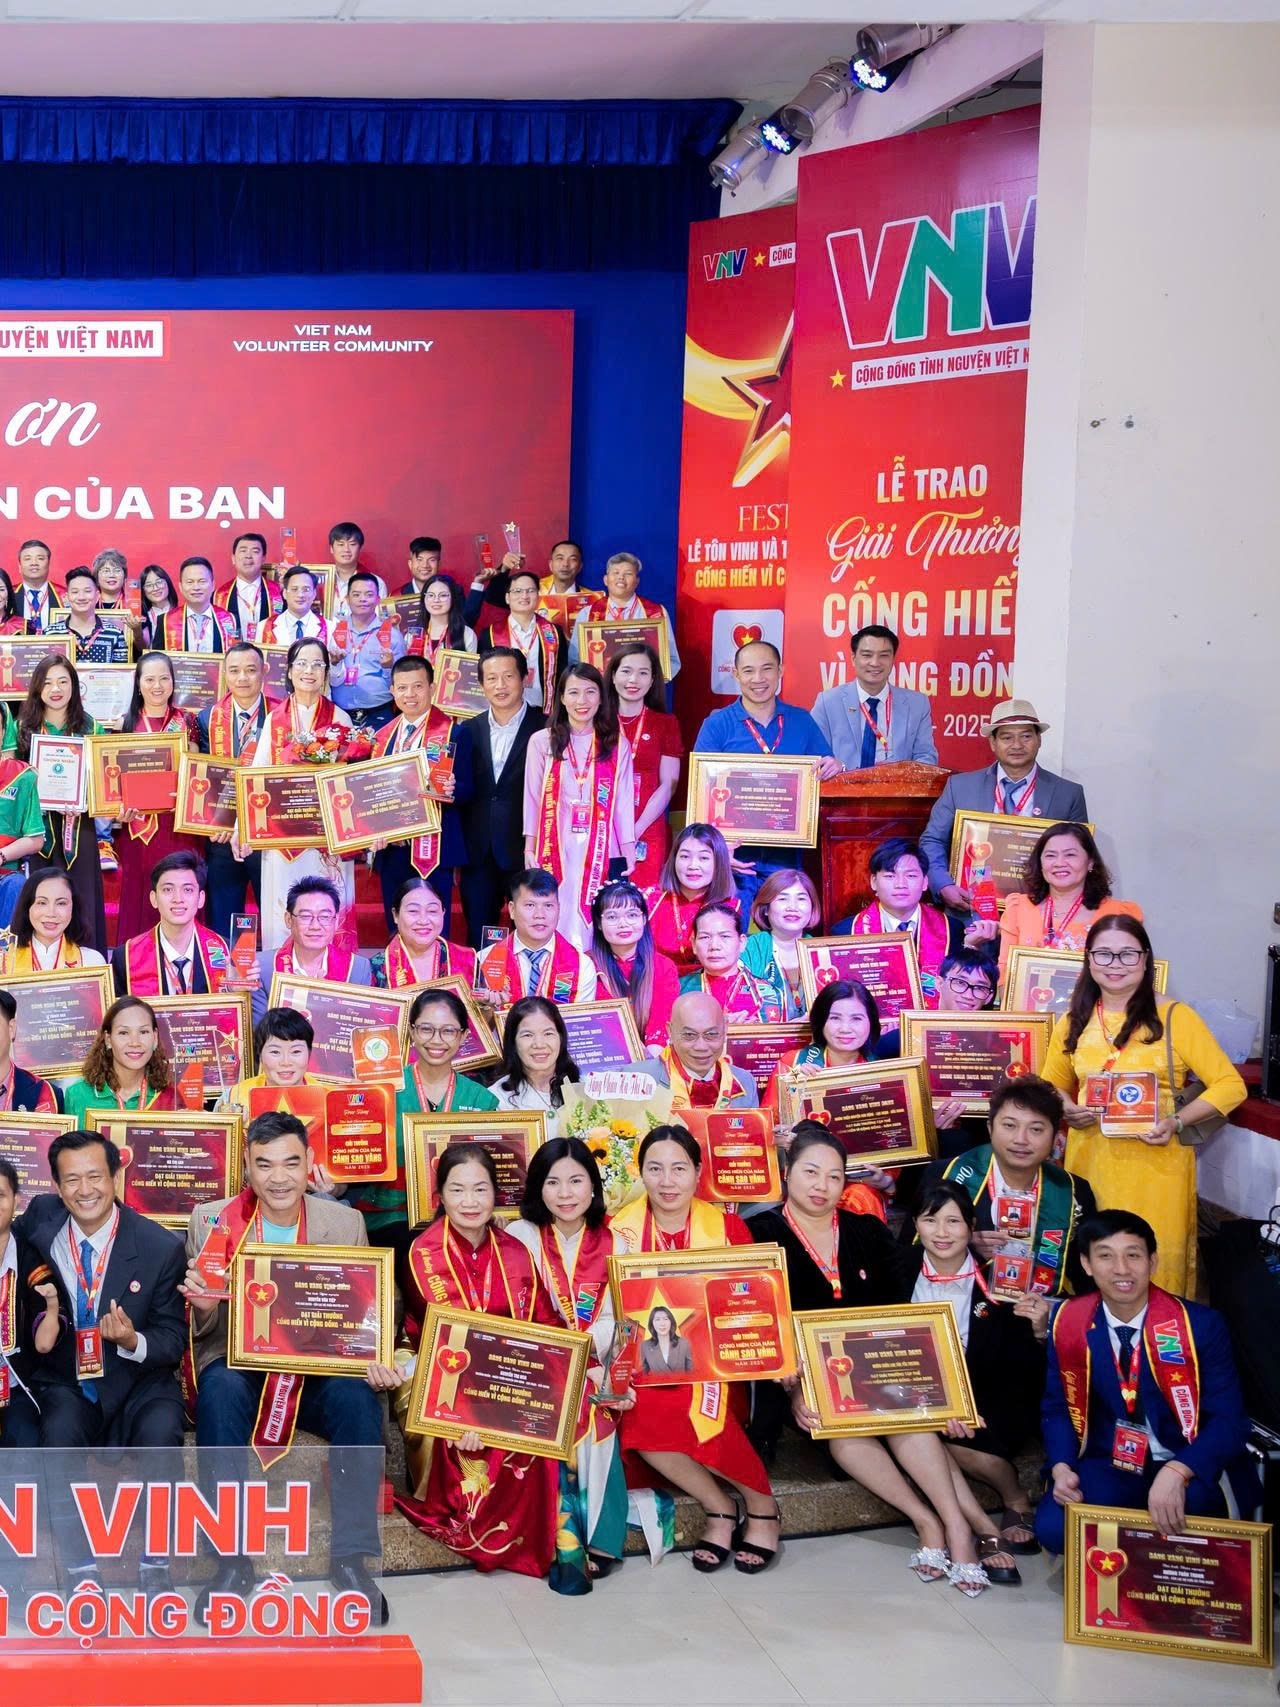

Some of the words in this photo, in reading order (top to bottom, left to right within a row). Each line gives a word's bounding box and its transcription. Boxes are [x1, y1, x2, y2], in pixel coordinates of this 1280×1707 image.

[703, 248, 747, 282] VNV
[771, 246, 794, 265] CỘNG
[826, 195, 1038, 350] VNV
[57, 325, 99, 353] VIỆT
[106, 329, 154, 349] NAM
[233, 339, 330, 352] VOLUNTEER
[333, 339, 434, 352] COMMUNITY
[294, 324, 330, 336] VIET
[334, 324, 372, 336] NAM
[856, 364, 884, 386] CỘNG
[887, 359, 916, 380] ĐỒNG
[920, 356, 944, 375] TÌNH
[947, 349, 991, 373] NGUYỆN
[995, 345, 1020, 369] VIỆT
[4, 397, 101, 448] ơn
[877, 455, 906, 504] LỄ
[913, 464, 988, 501] TRAO
[33, 476, 153, 521] CỦA
[169, 486, 286, 529] BẠN
[688, 540, 702, 563] LỄ
[704, 538, 728, 562] TÔN
[730, 540, 758, 562] VINH
[760, 536, 779, 561] VÀ
[827, 516, 897, 583] Giải
[906, 506, 1022, 572] Thưởn
[695, 564, 727, 590] CỐNG
[729, 564, 758, 588] HIẾN
[759, 564, 775, 587] VÌ
[822, 575, 927, 638] CỐNG
[944, 570, 1017, 637] HIẾ
[949, 650, 1014, 698] ĐỒN
[598, 777, 611, 807] VNV
[1038, 1229, 1063, 1268] VNV
[428, 1274, 449, 1304] CỐNG
[576, 1283, 601, 1322] VNV
[1153, 1319, 1186, 1365] VNV
[70, 1480, 311, 1558] VINH
[25, 1578, 189, 1650] CỘNG
[204, 1572, 372, 1639] ĐỒNG
